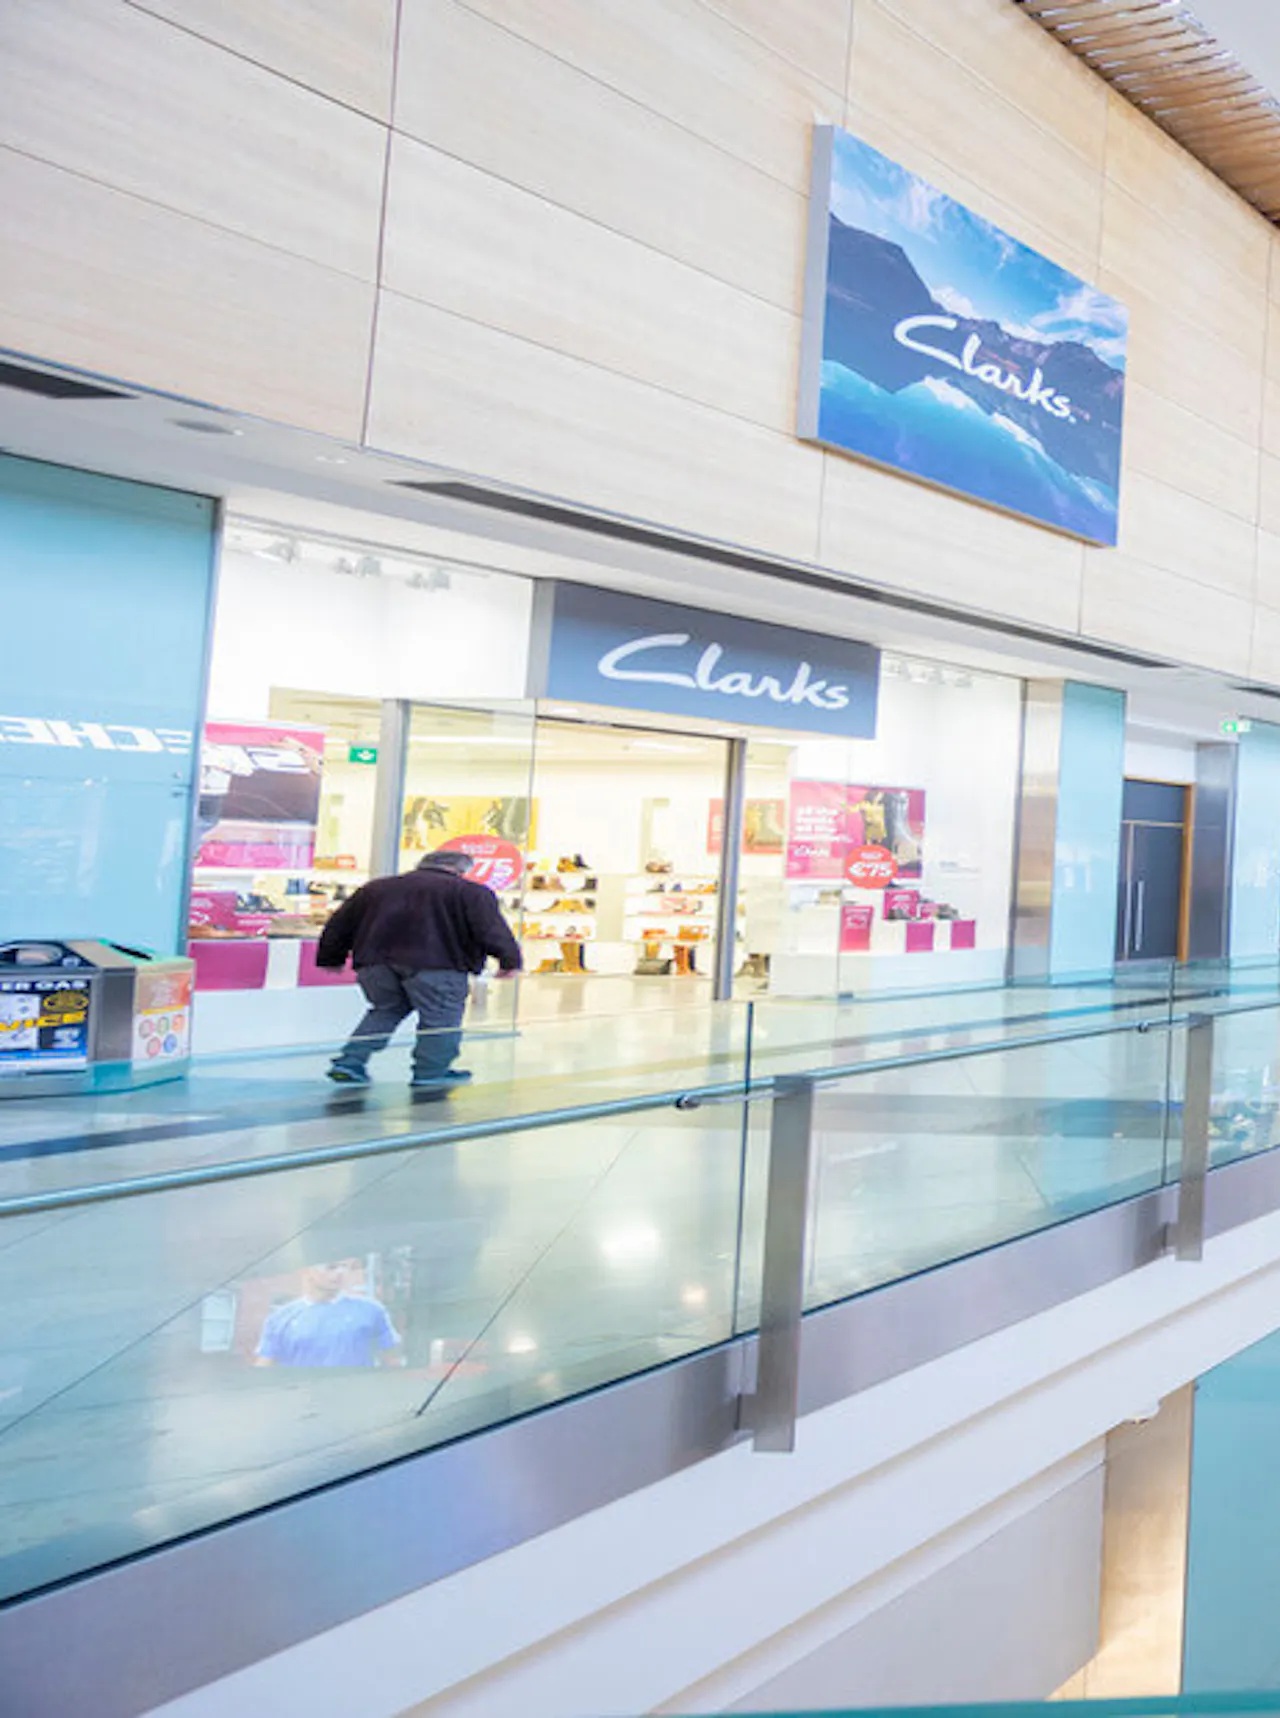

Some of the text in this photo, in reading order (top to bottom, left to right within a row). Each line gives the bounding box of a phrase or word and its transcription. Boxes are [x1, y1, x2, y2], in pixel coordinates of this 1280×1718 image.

[598, 633, 849, 709] Clarks
[466, 857, 515, 878] 75
[849, 861, 893, 878] €75
